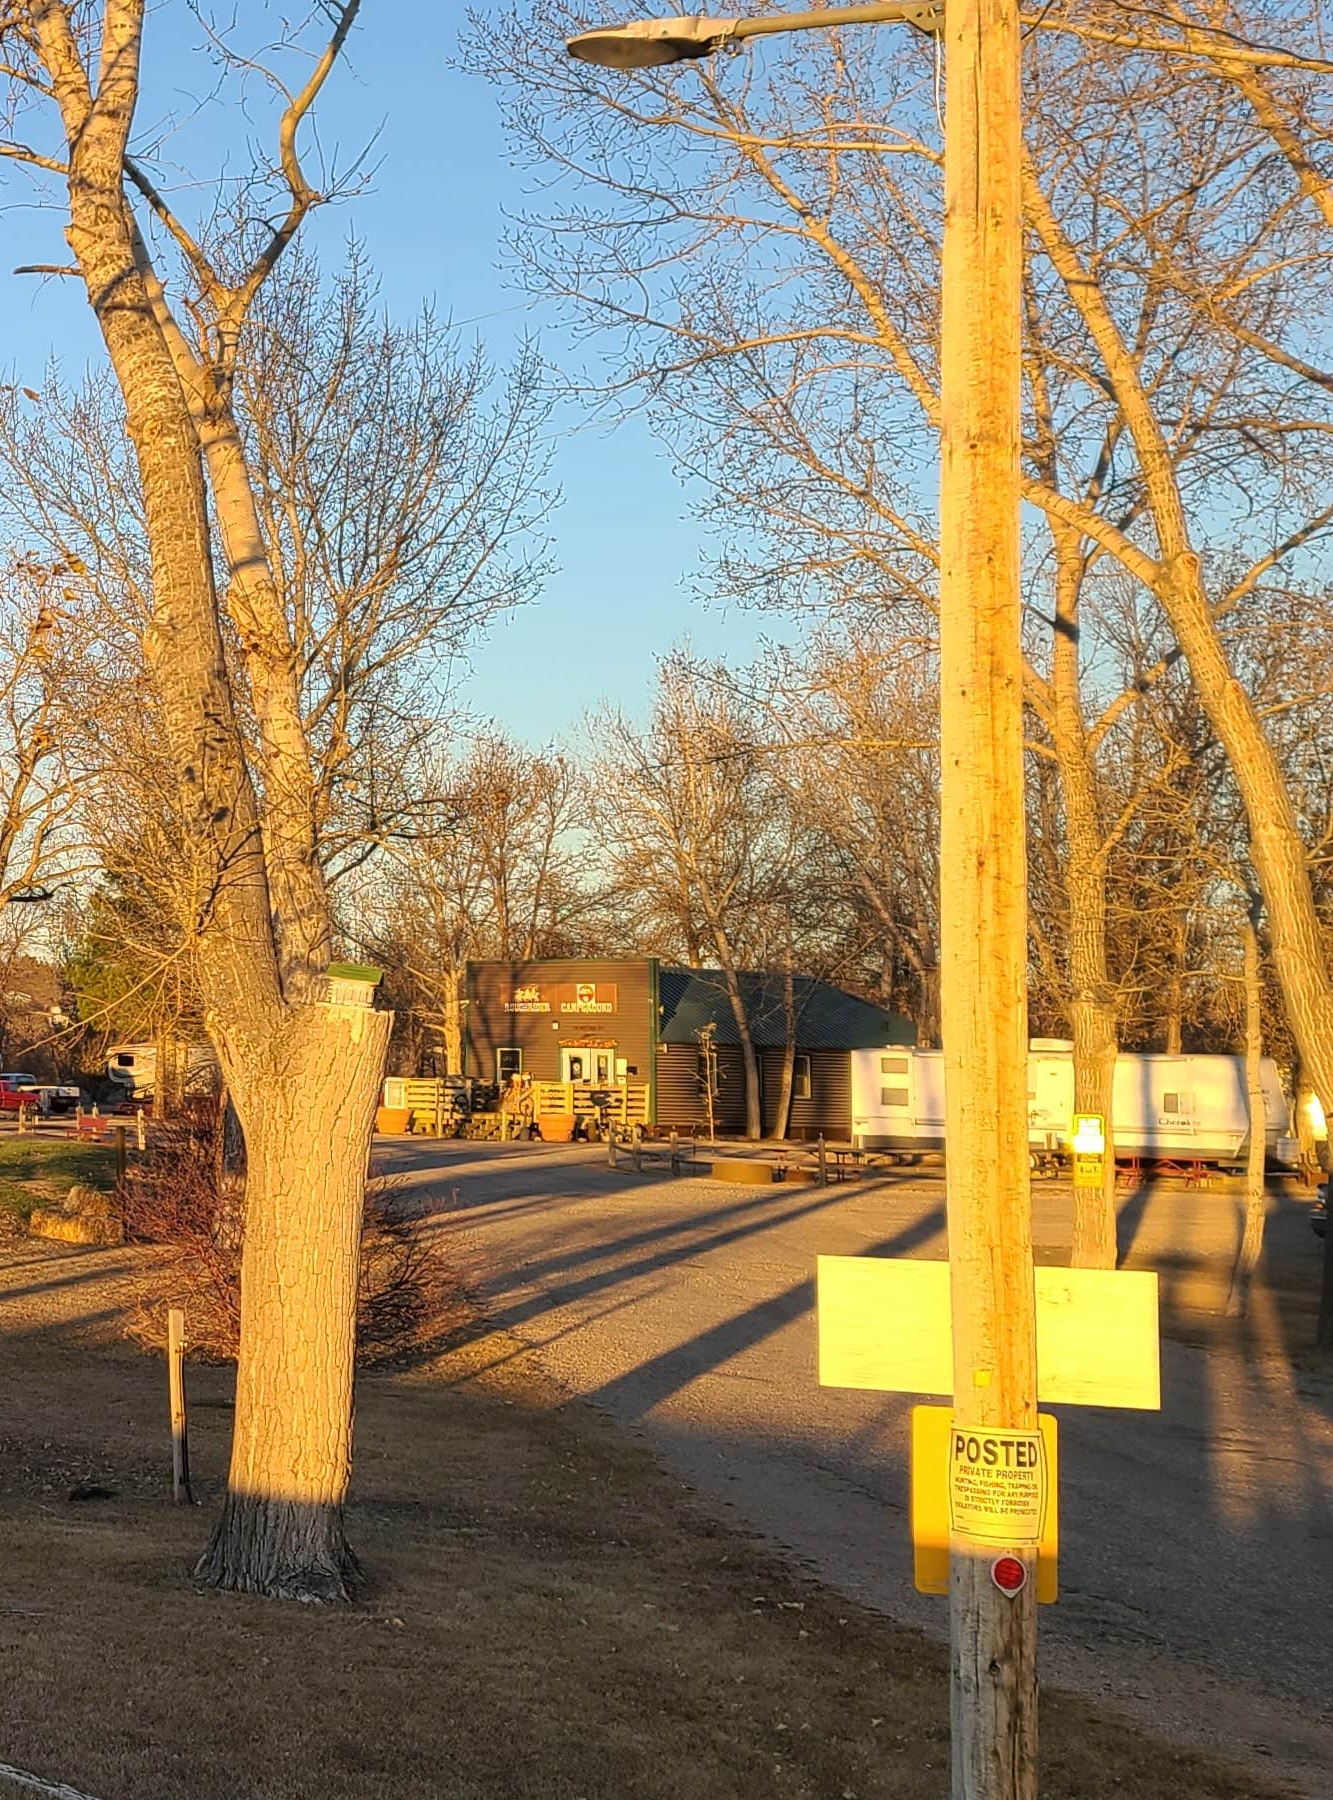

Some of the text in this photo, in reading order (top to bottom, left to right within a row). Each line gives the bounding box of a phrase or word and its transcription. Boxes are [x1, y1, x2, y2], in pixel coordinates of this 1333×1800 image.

[954, 1434, 1038, 1468] POSTED
[958, 1464, 1034, 1481] PRIVATE PROPERTY
